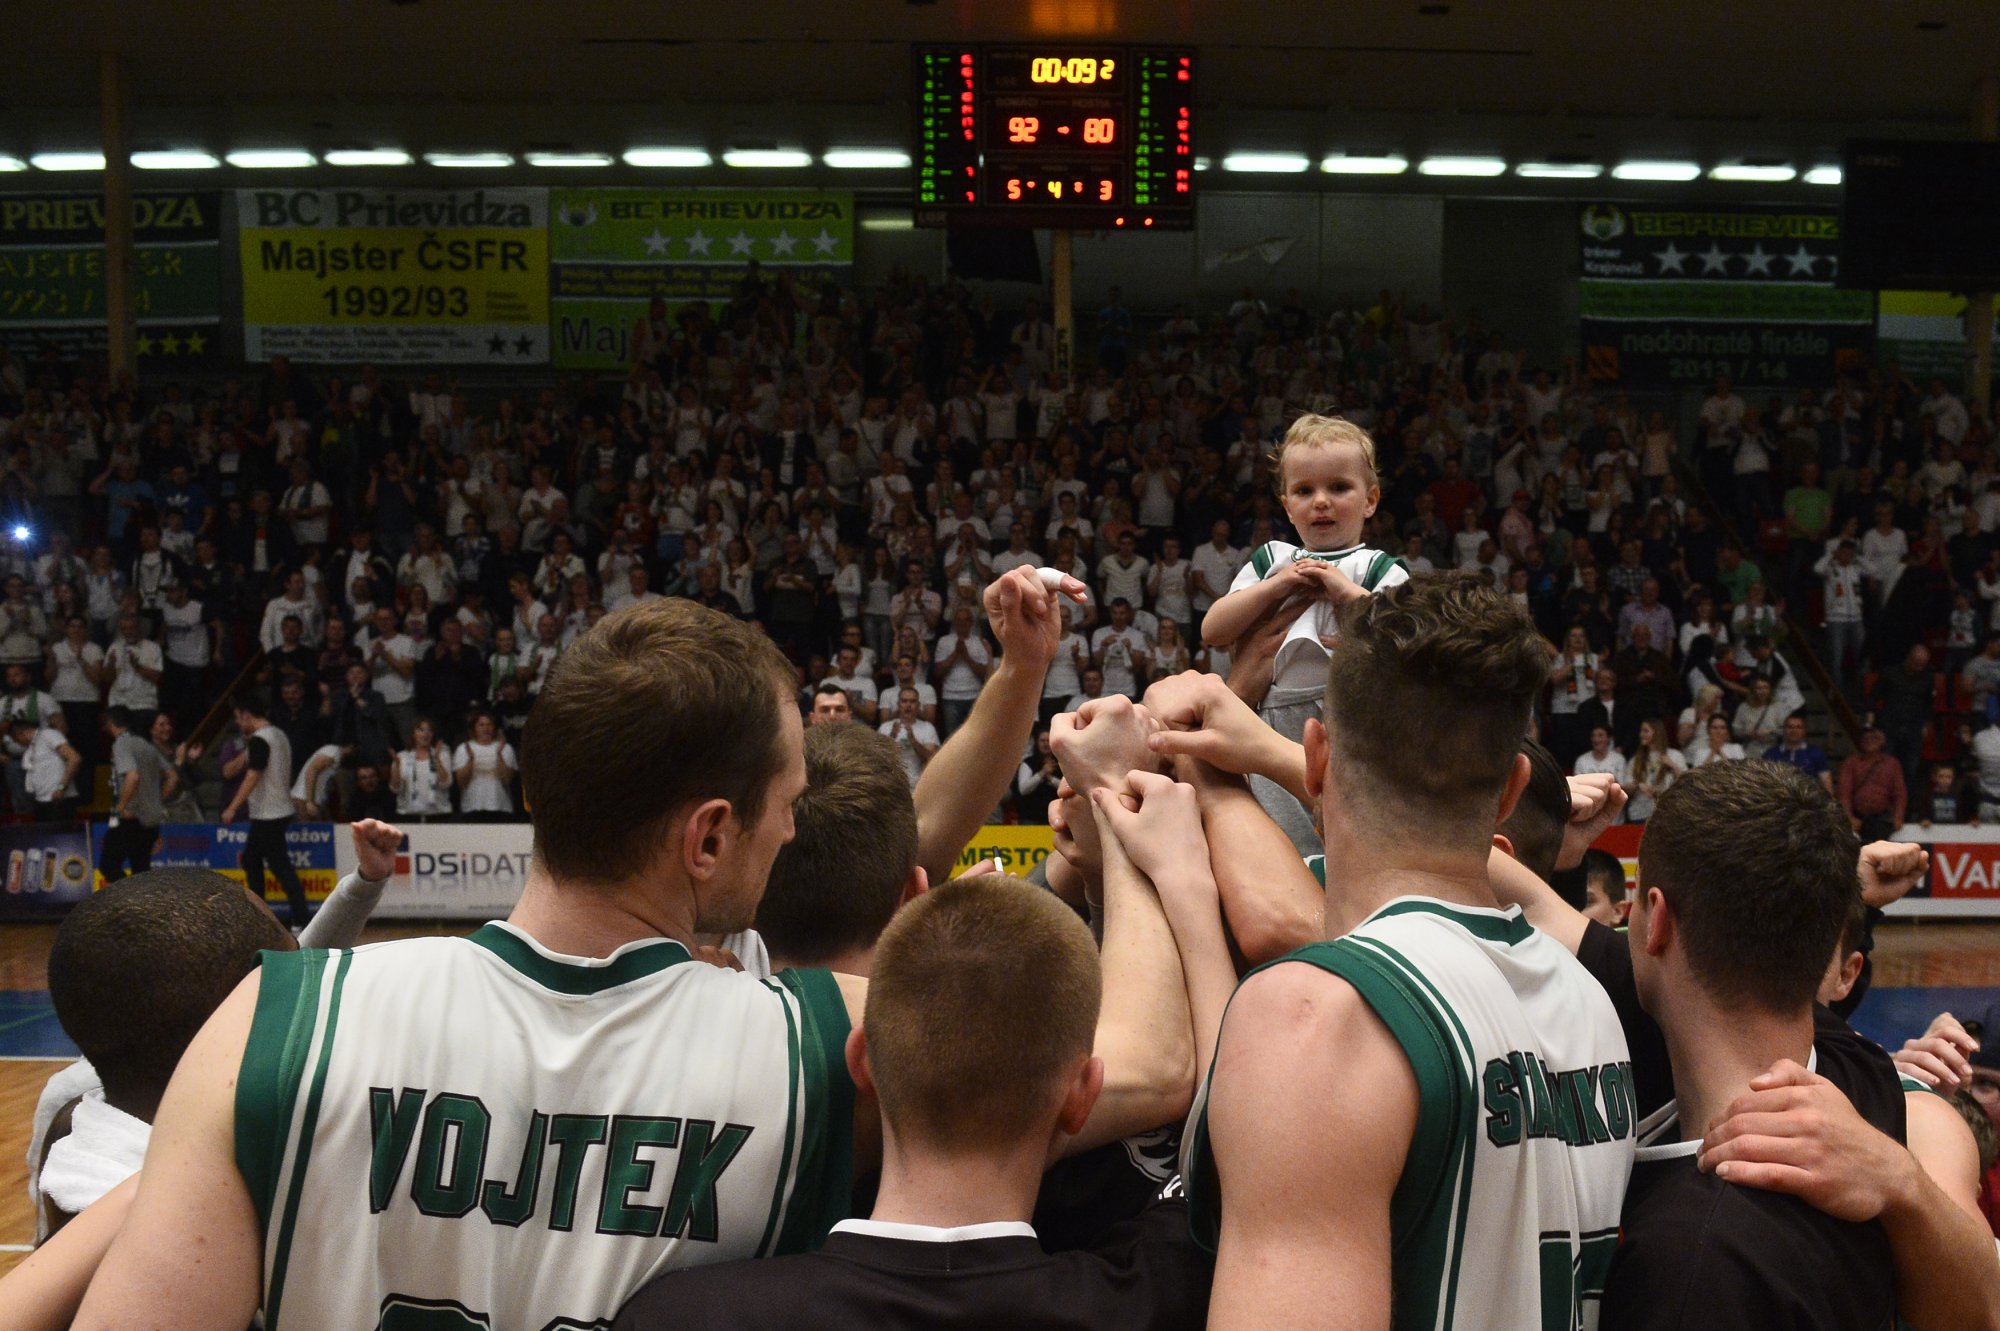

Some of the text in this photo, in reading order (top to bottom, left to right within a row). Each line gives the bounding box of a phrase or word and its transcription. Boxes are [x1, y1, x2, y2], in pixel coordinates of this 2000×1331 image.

[1100, 59, 1115, 80] 2
[1009, 117, 1039, 142] 92
[1083, 118, 1115, 143] 80
[1008, 179, 1021, 200] 5
[1047, 181, 1062, 199] 4
[1099, 180, 1113, 201] 3
[2, 197, 204, 231] PRIEVDZA
[255, 190, 533, 227] BC Prievidza
[610, 200, 843, 220] BC PRIEVIDZA
[260, 231, 528, 278] Majster ČSFR
[323, 286, 469, 318] 1992/93
[368, 1086, 755, 1243] VOJTEK
